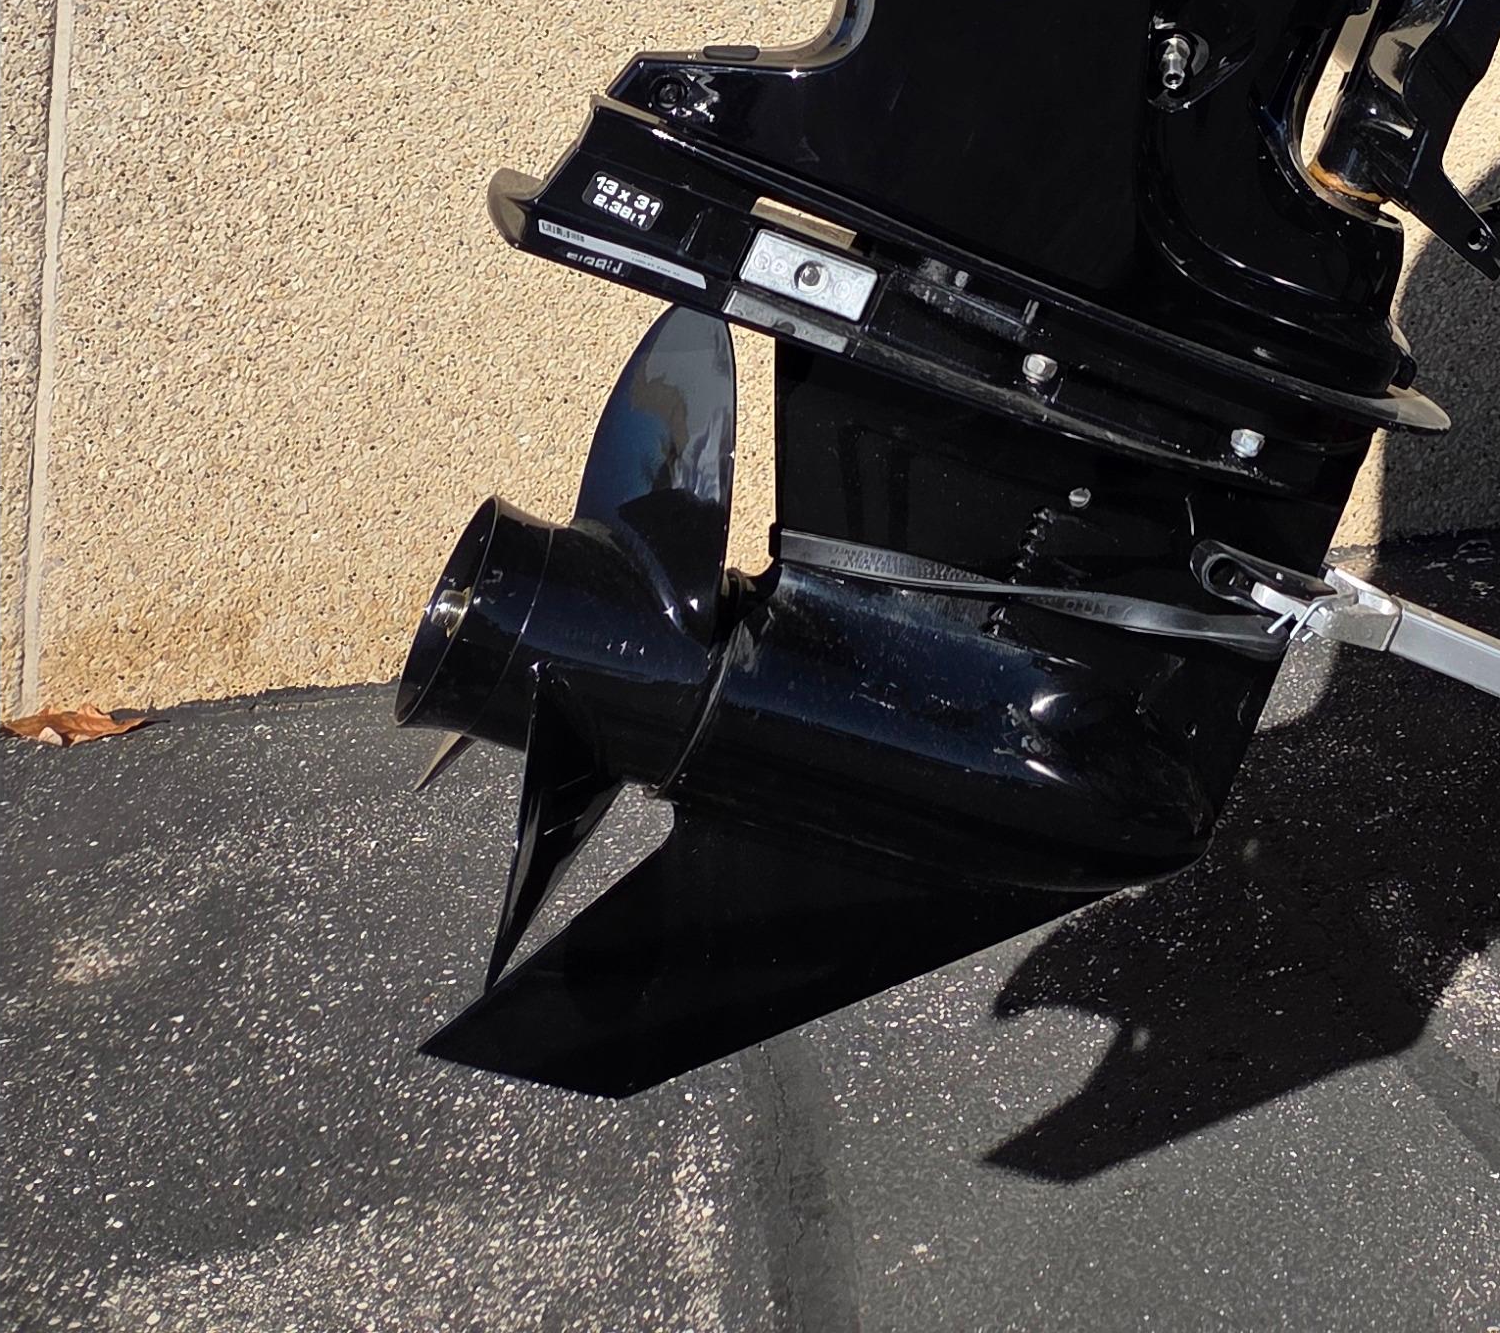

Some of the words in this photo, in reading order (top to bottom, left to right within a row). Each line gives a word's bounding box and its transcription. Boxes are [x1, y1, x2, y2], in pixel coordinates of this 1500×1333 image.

[596, 176, 619, 196] 13
[617, 189, 631, 203] x
[633, 194, 661, 216] 31
